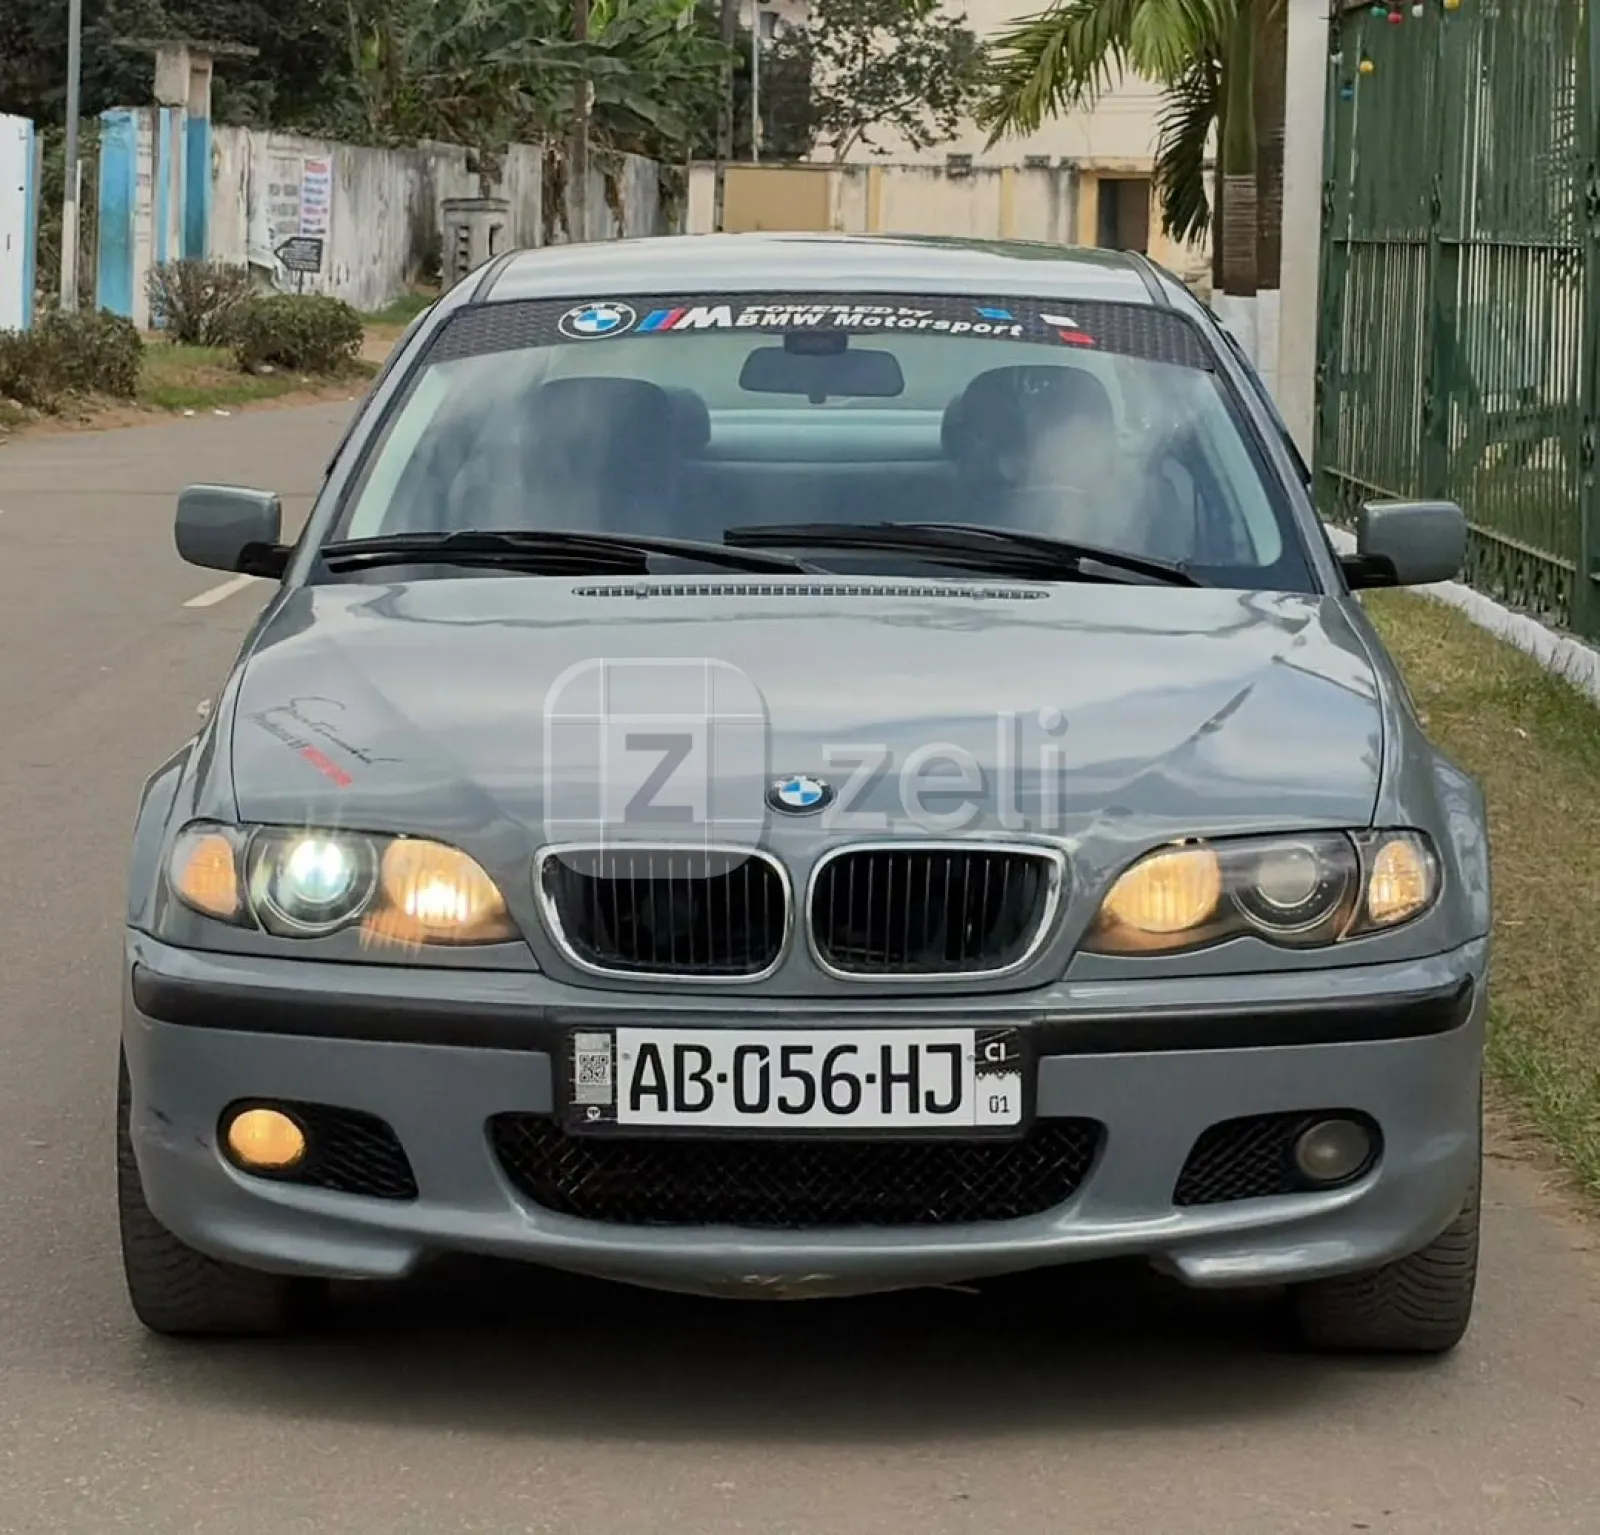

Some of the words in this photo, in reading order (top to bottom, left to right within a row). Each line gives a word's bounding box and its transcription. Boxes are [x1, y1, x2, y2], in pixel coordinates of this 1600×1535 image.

[672, 306, 732, 329] M
[744, 304, 897, 315] POWERED
[898, 307, 933, 317] by
[735, 313, 823, 327] BMW
[834, 313, 1024, 336] Motorsport
[984, 1042, 1006, 1061] CI
[989, 1095, 1010, 1114] 01
